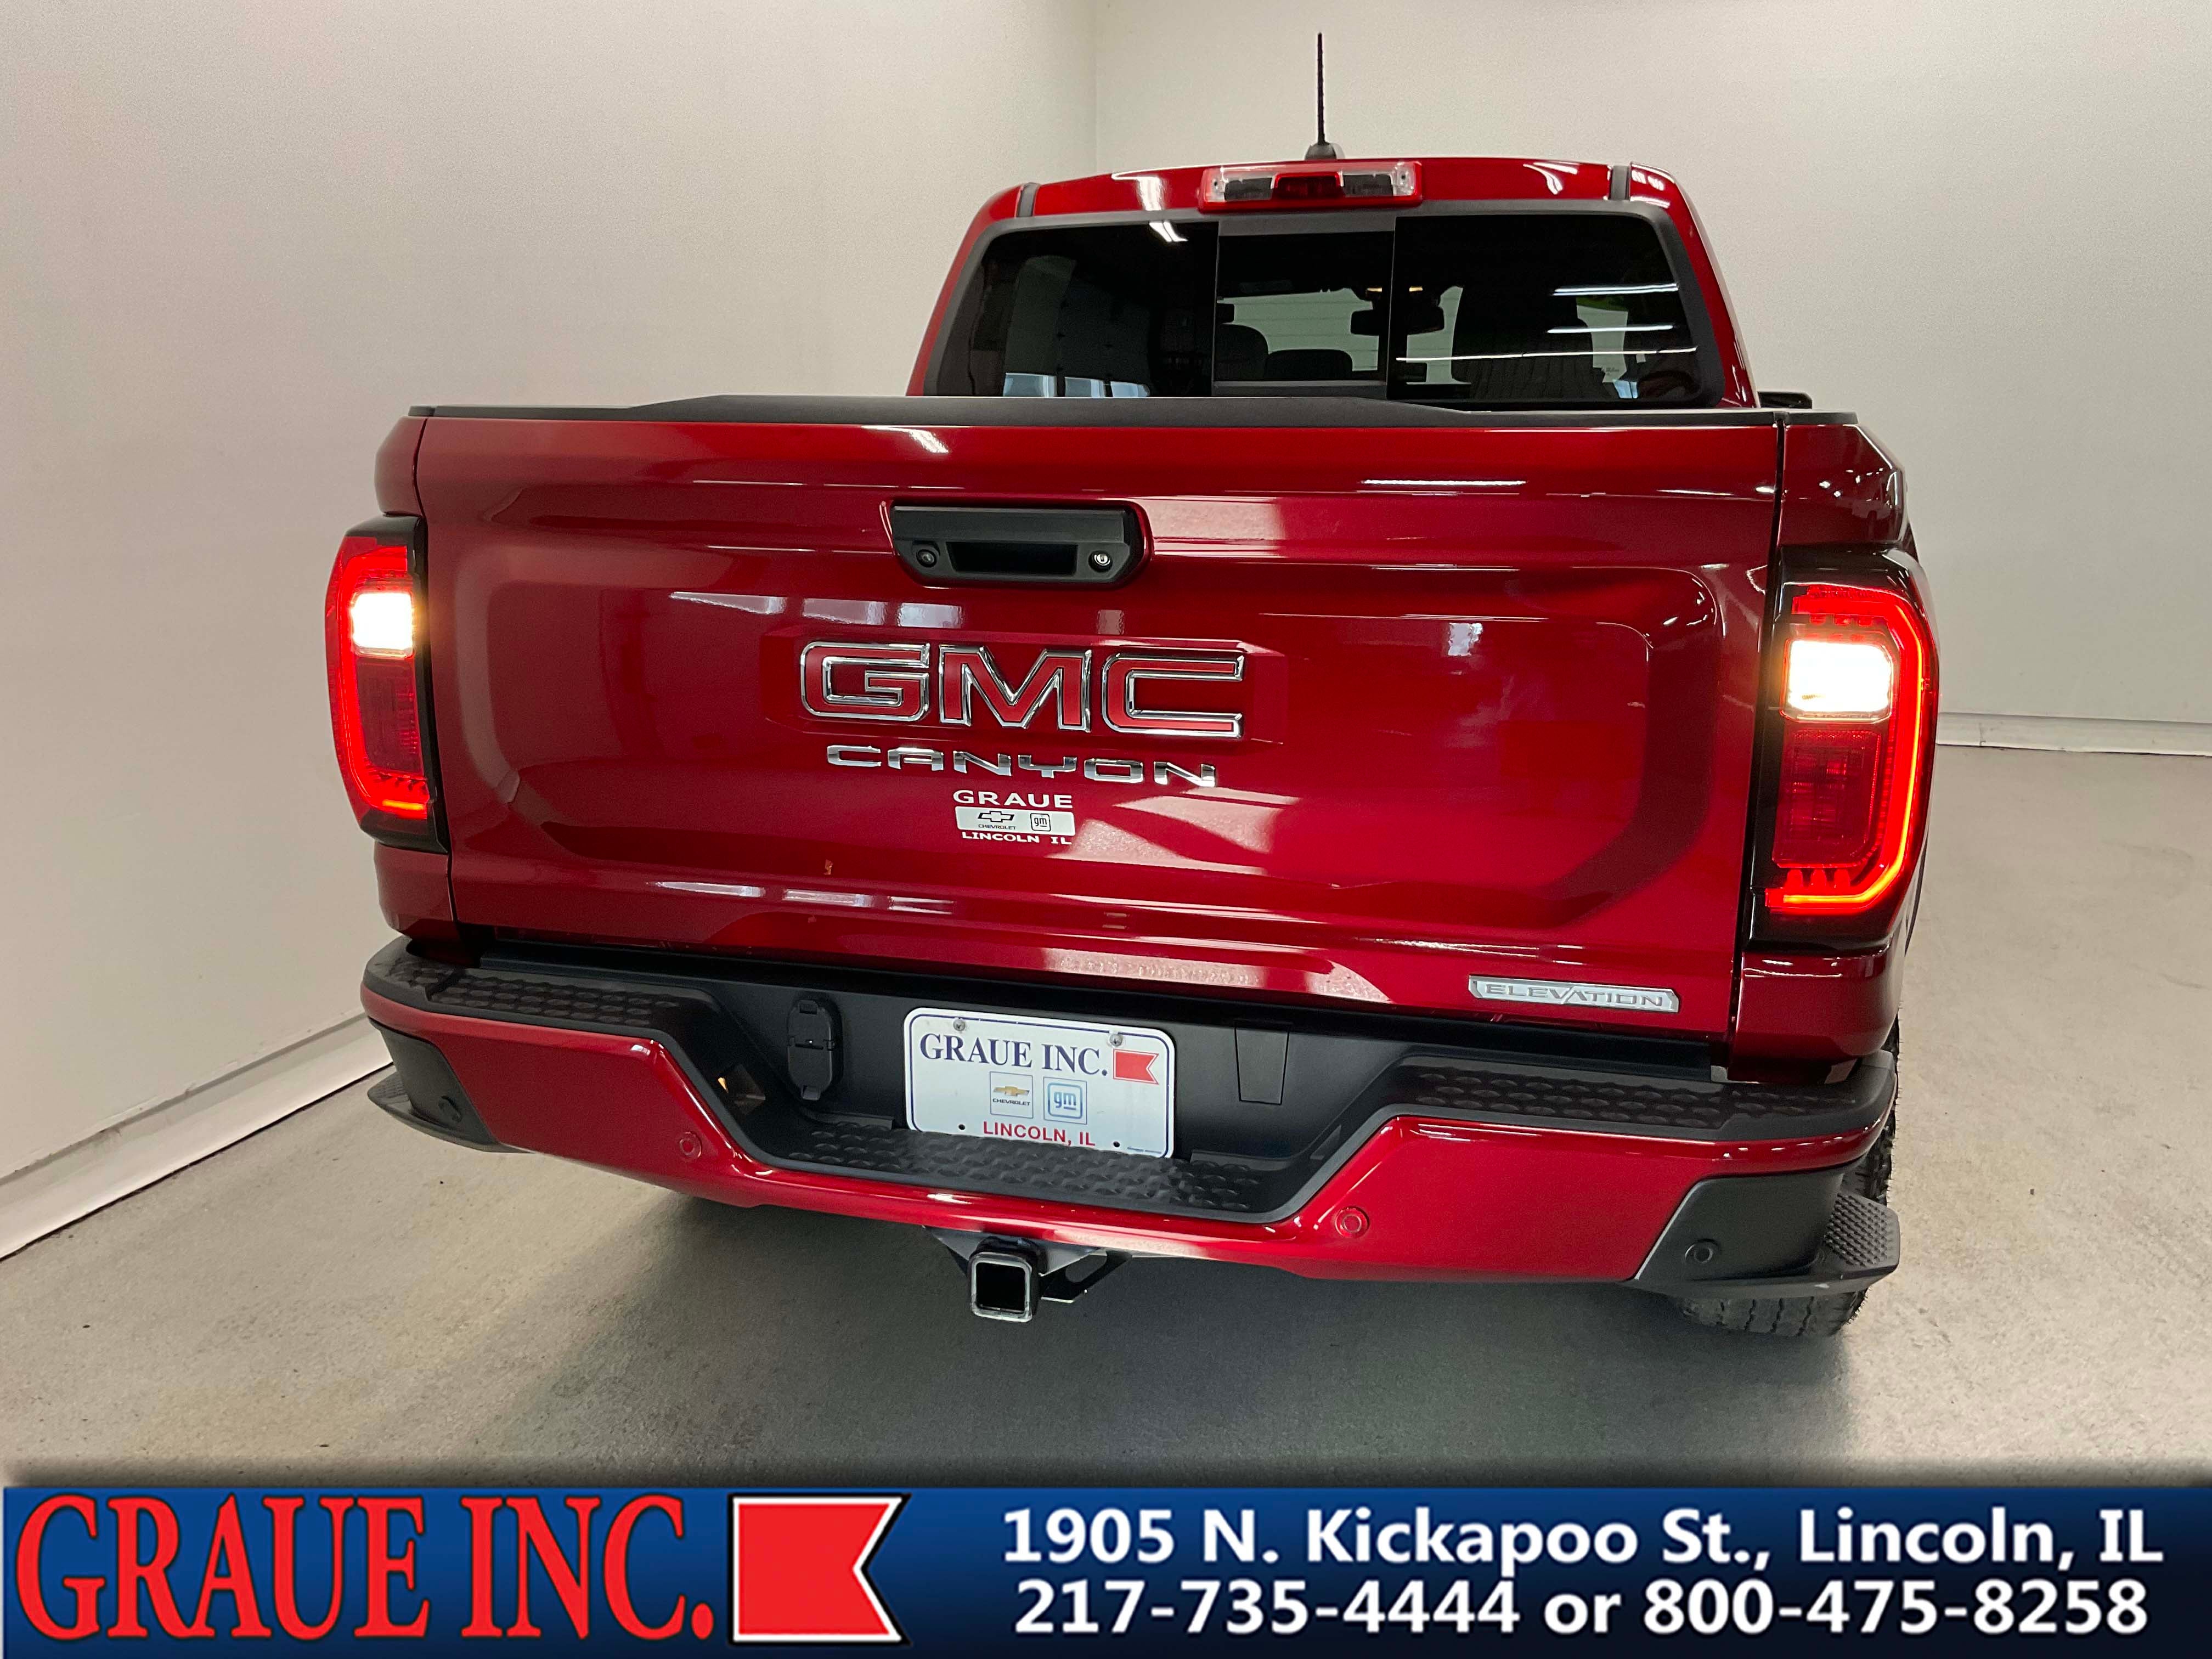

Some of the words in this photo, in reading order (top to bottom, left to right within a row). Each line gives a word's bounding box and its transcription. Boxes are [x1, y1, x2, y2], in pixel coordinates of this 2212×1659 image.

[800, 641, 1245, 739] GMC
[827, 744, 1216, 787] CANYON
[953, 789, 1073, 809] GRAUE
[1034, 817, 1047, 827] gm
[961, 831, 1040, 843] LINCOLN
[1050, 836, 1072, 845] IL
[1486, 983, 1663, 1007] ELEVATION
[919, 1033, 1032, 1067] GRAUE
[1041, 1043, 1108, 1076] INC.
[992, 1097, 1031, 1107] CHEVROLET
[1053, 1090, 1077, 1110] gm
[983, 1120, 1071, 1146] LINCOLN,
[1079, 1131, 1096, 1146] IL
